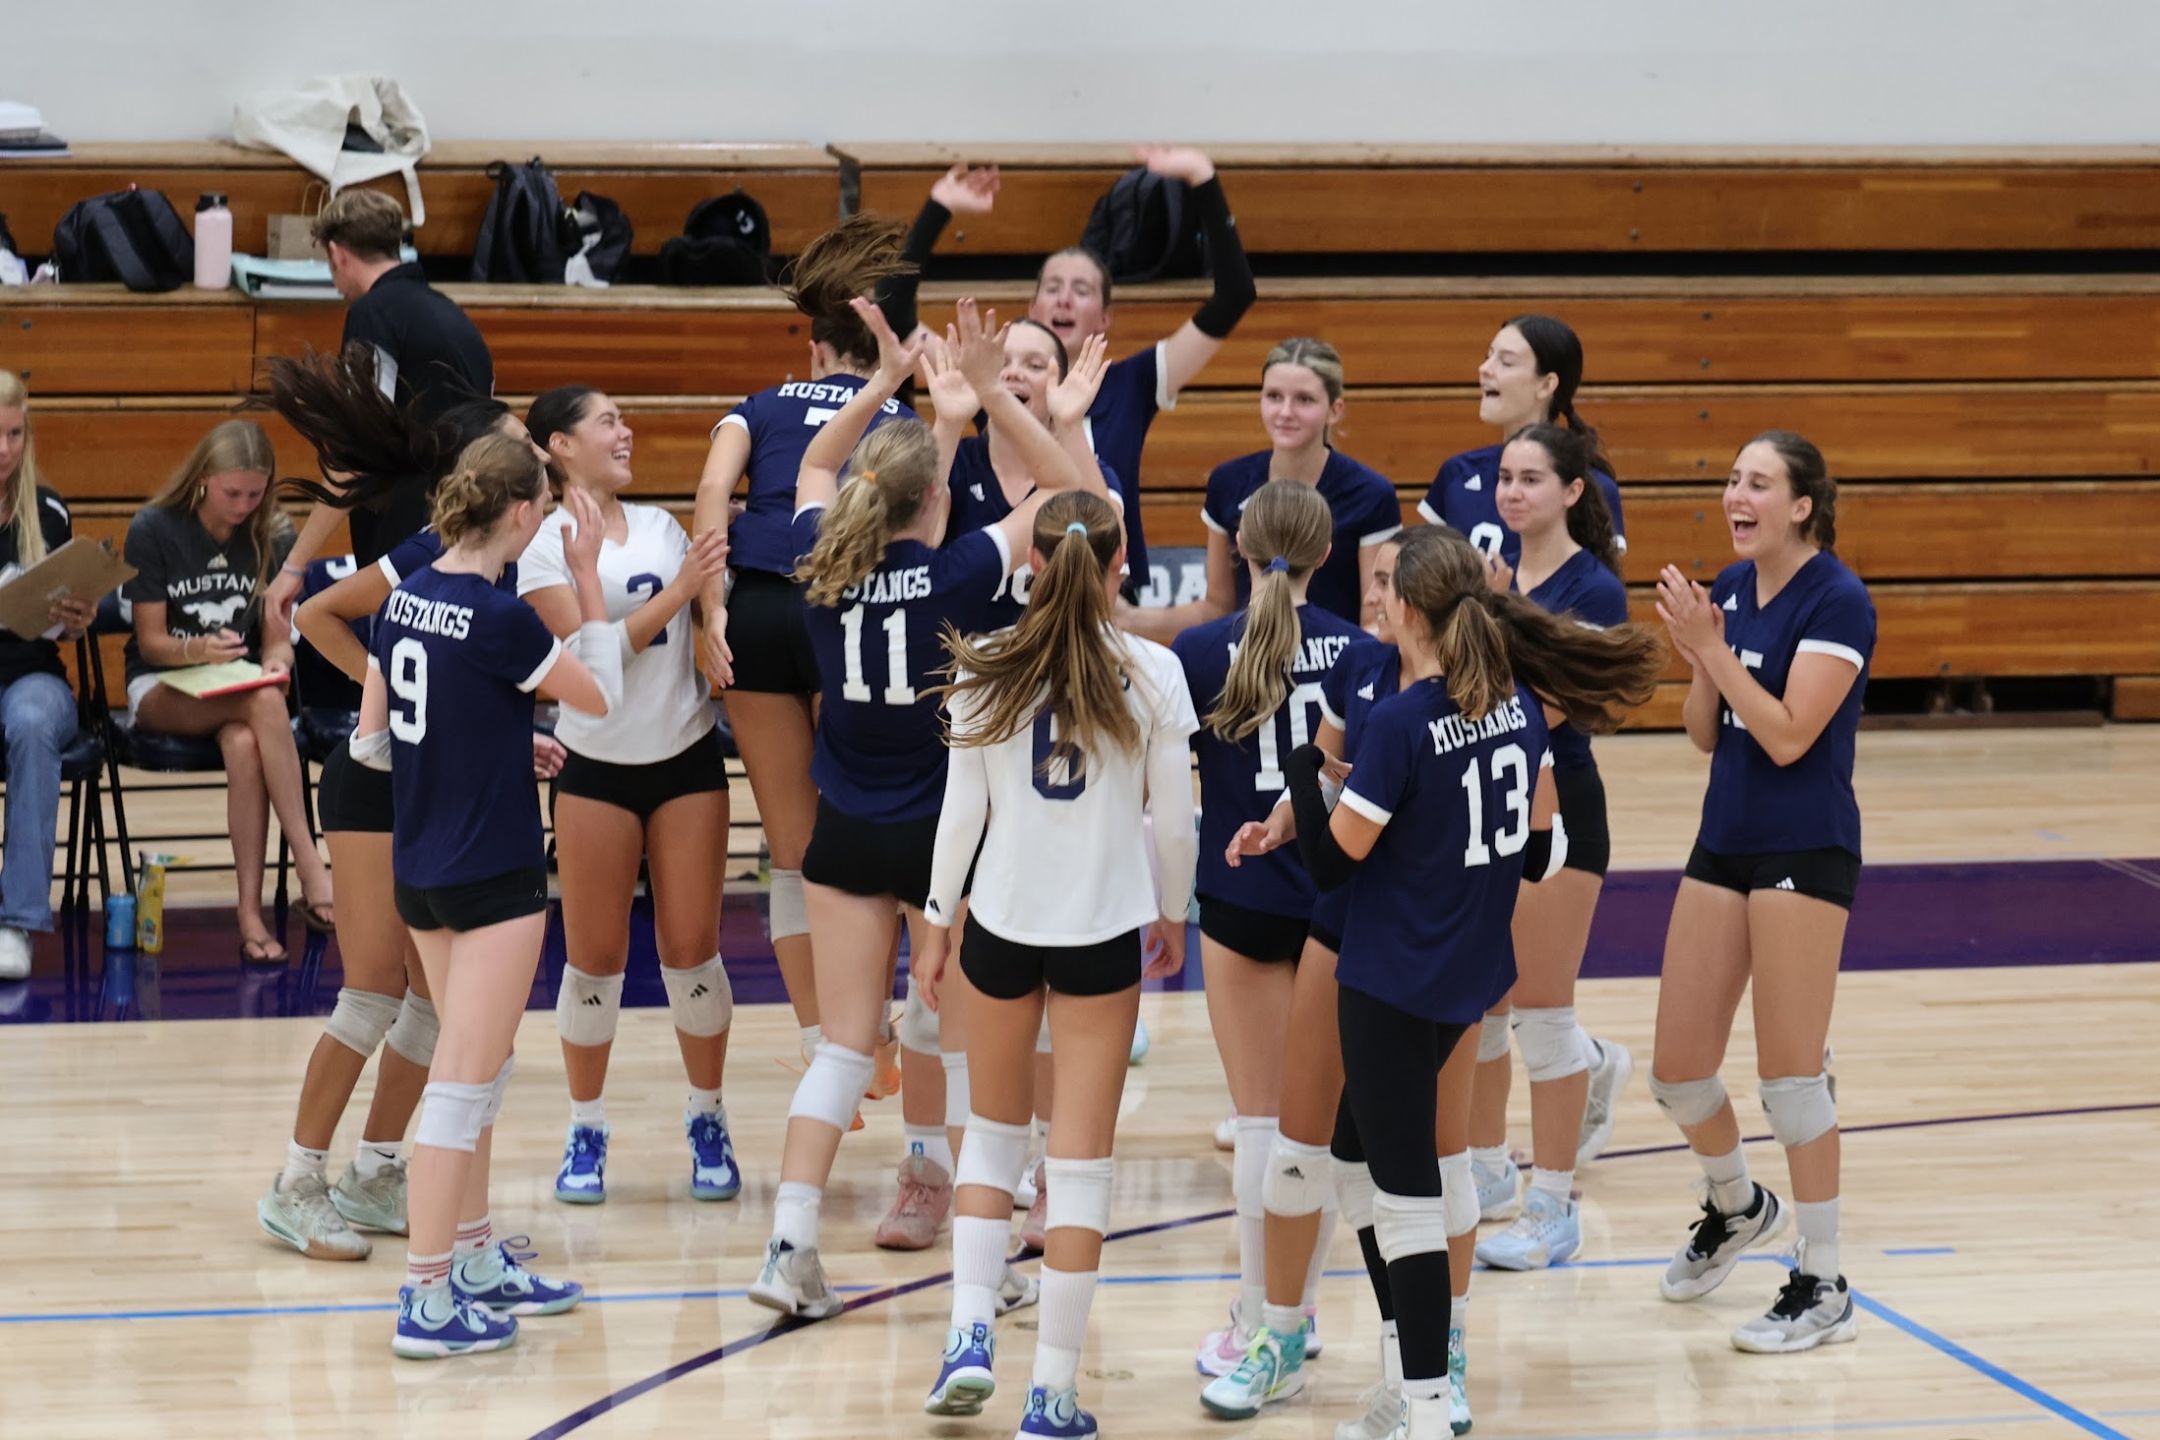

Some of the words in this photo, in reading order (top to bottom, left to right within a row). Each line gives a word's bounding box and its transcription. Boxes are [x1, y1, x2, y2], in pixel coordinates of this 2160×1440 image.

[778, 382, 900, 415] MUSTAS
[167, 573, 256, 599] MUSTAN
[842, 565, 932, 603] TANGS
[840, 603, 915, 705] 11
[389, 646, 428, 745] 9
[1428, 695, 1527, 755] MUSTANGS
[1461, 743, 1529, 867] 13
